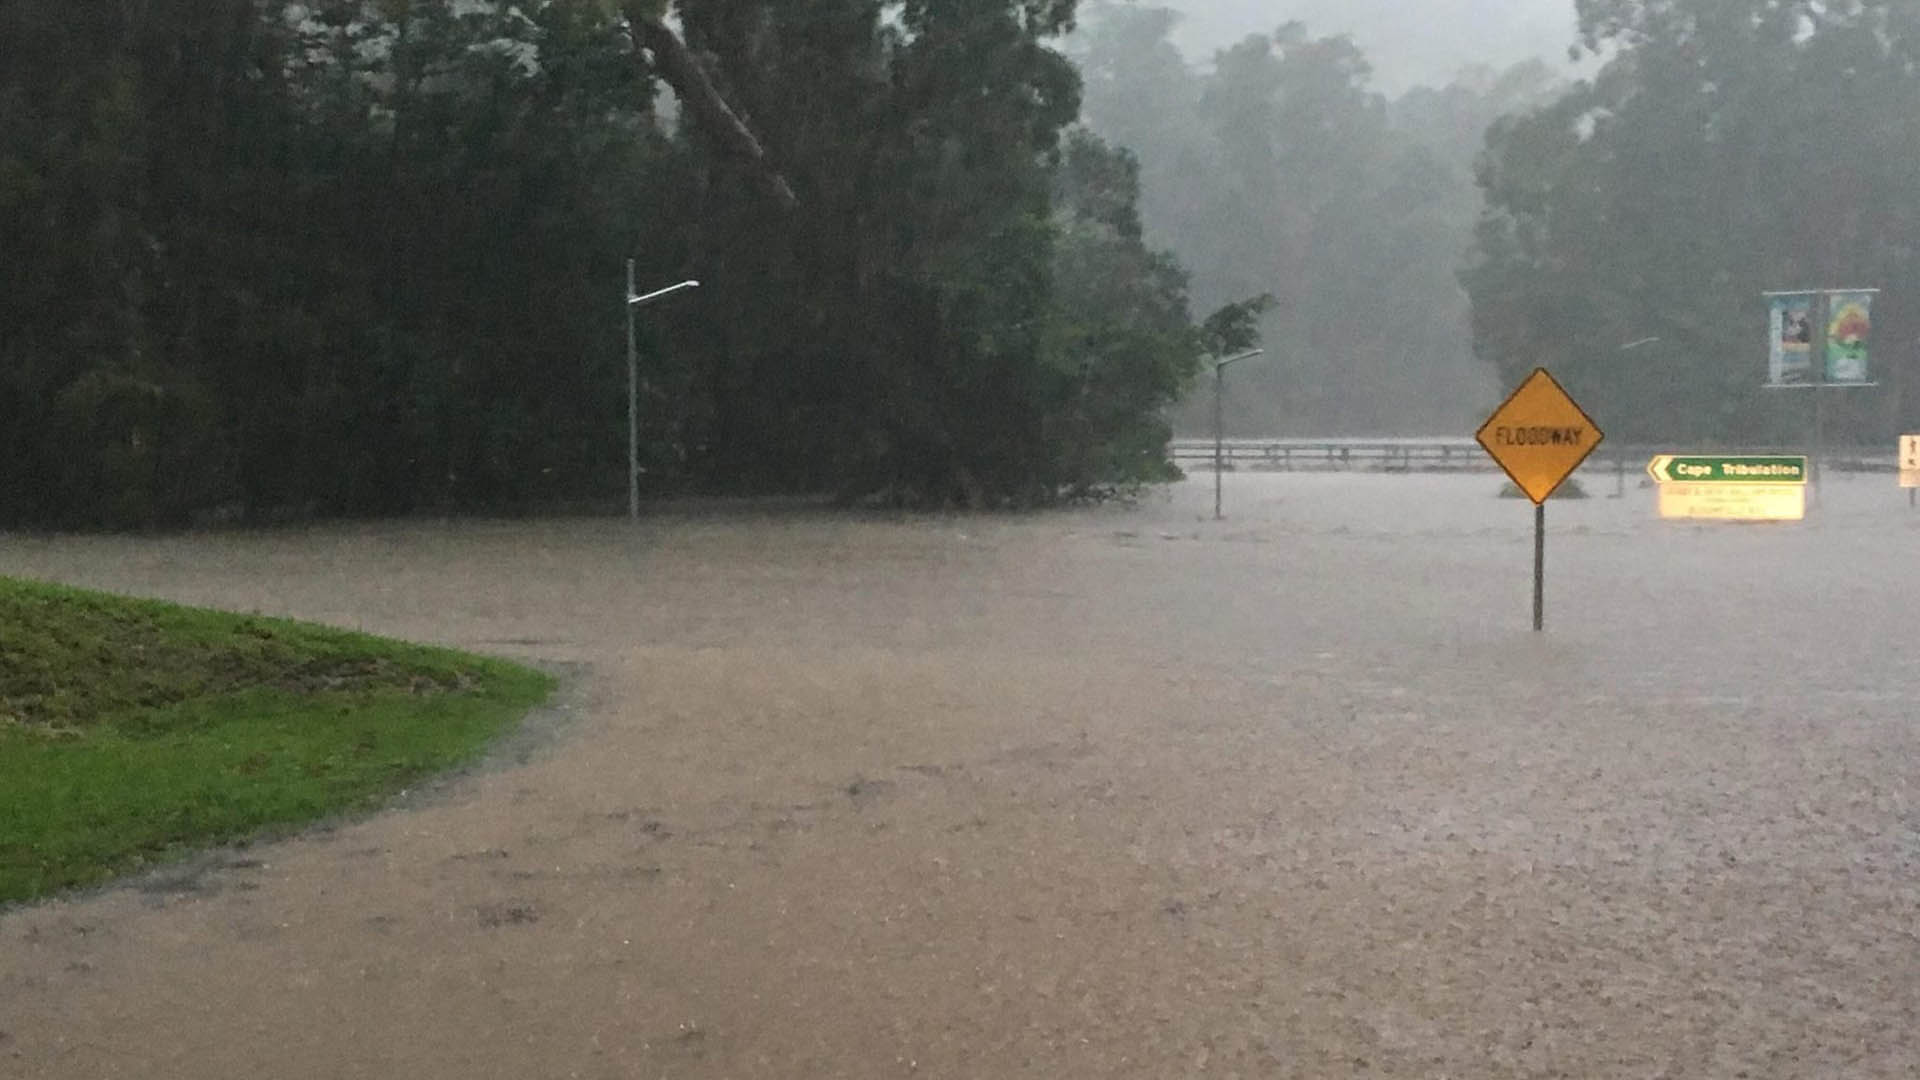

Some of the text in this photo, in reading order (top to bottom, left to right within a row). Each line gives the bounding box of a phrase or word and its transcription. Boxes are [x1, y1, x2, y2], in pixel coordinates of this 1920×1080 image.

[1496, 426, 1582, 446] FLOODWAY
[1677, 463, 1800, 477] Cape Tribulation
